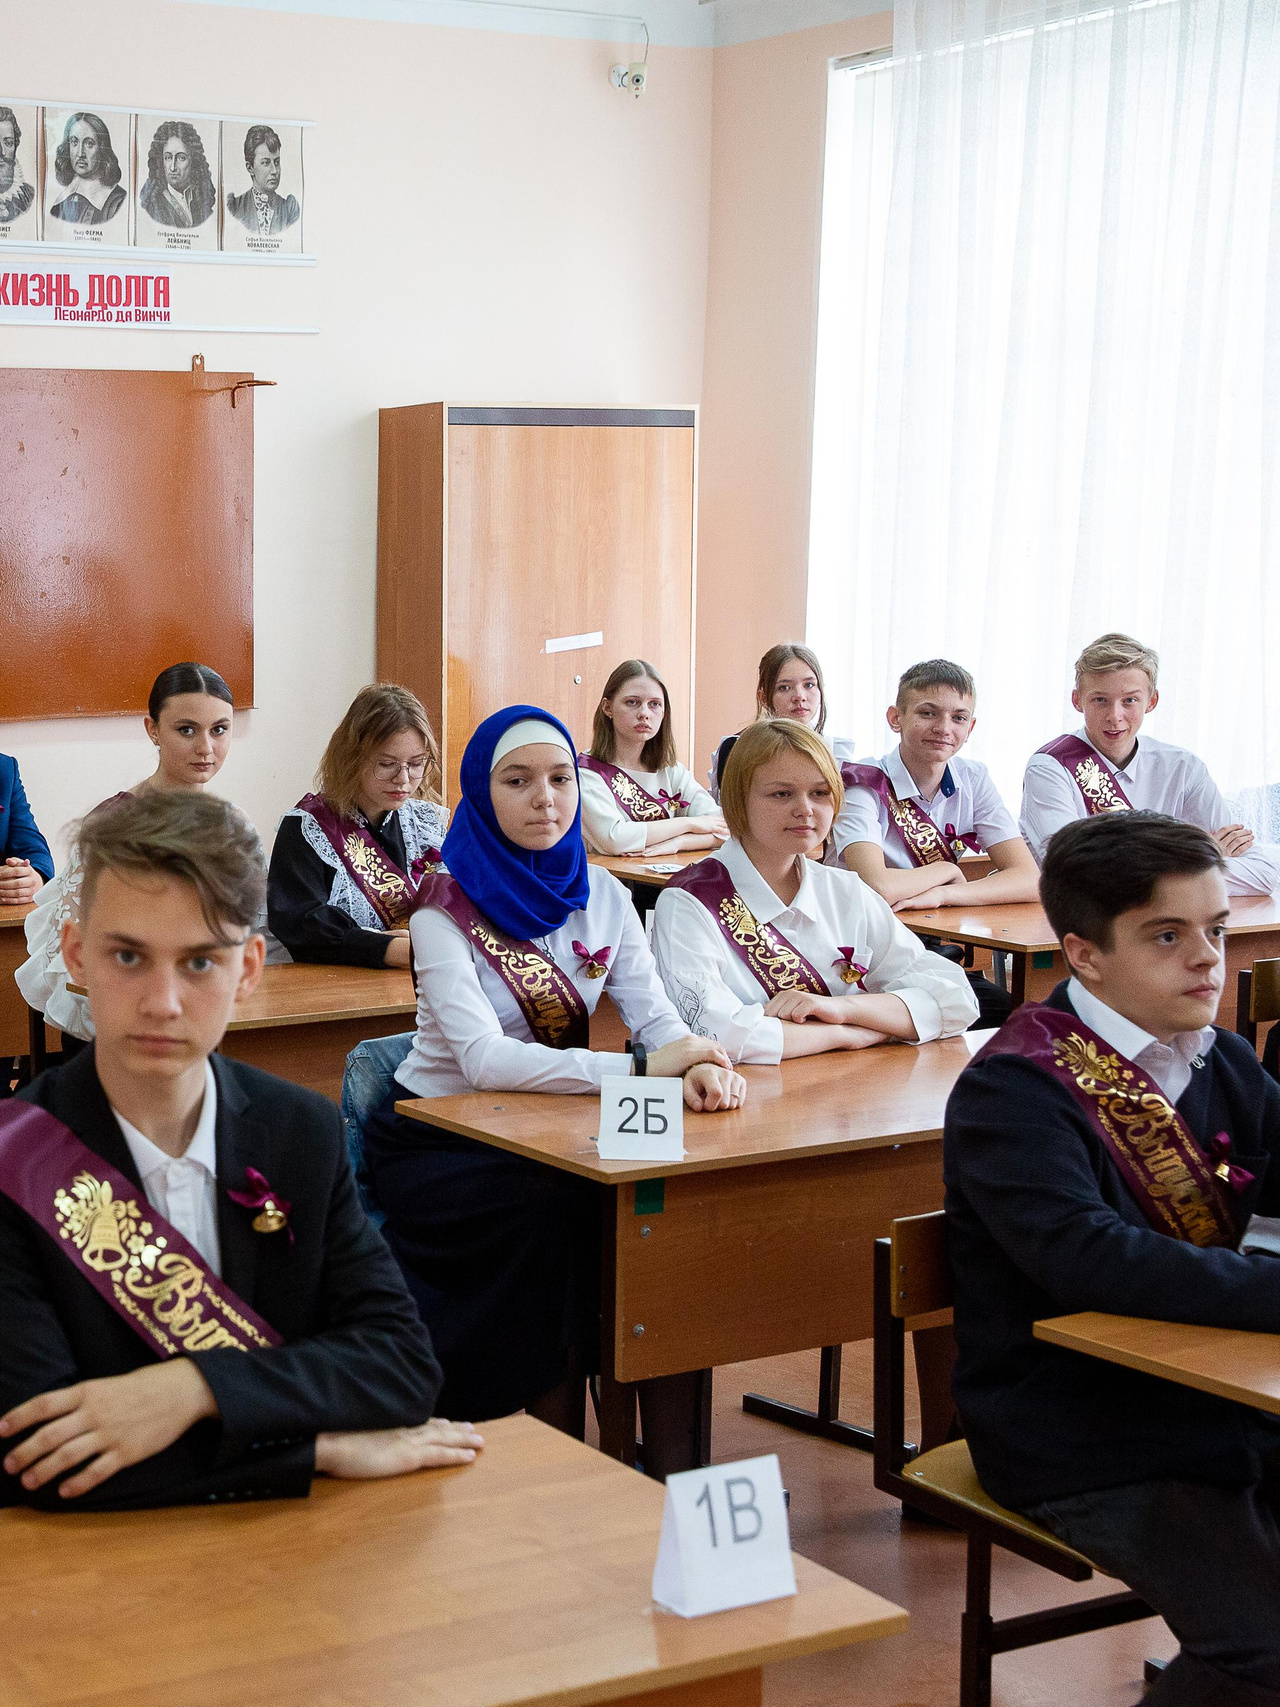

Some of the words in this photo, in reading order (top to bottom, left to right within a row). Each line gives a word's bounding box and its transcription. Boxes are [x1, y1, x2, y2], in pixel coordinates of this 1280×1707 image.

[86, 273, 170, 310] ДОЛГА
[617, 1096, 668, 1134] 2Б
[695, 1476, 763, 1548] 1В
